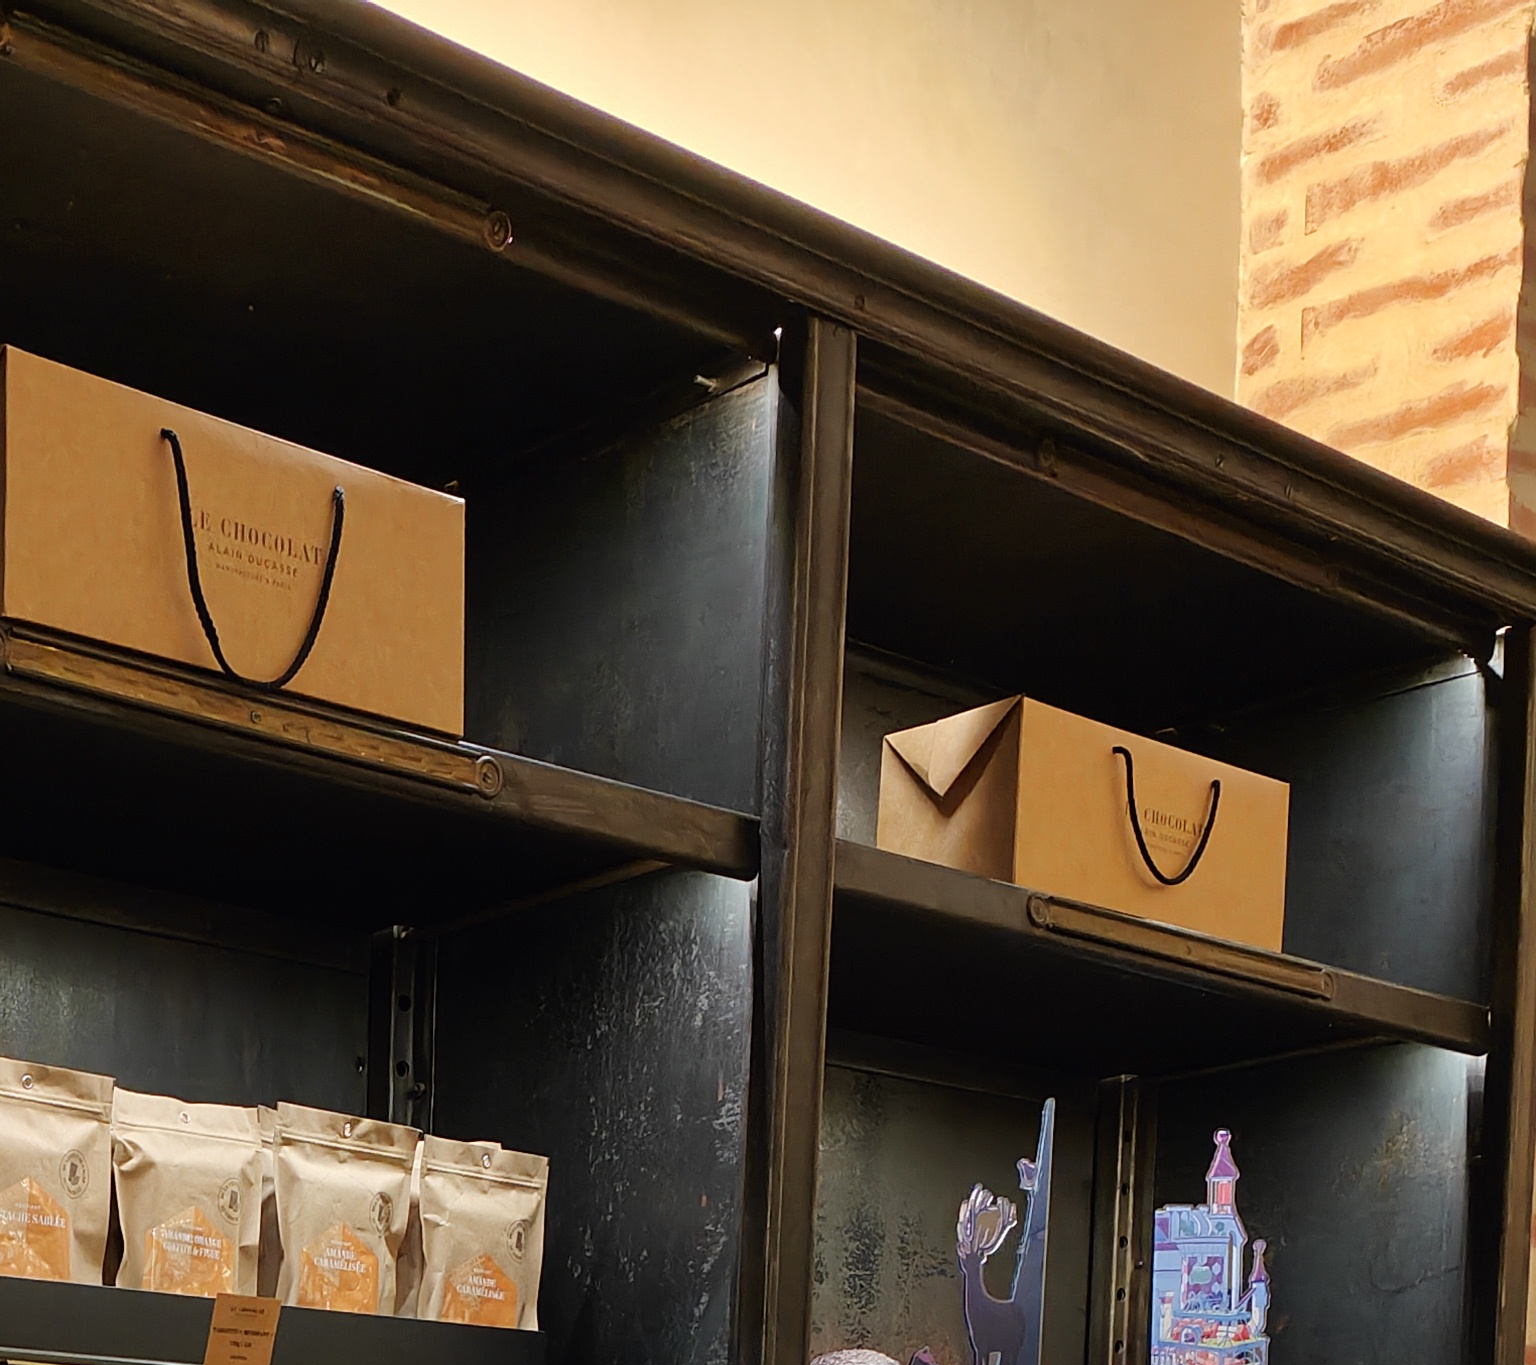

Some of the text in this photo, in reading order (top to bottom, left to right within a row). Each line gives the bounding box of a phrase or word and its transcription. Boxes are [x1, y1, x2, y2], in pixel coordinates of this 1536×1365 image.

[221, 518, 322, 566] CHOCOLAT
[208, 542, 298, 578] ALAIN DUCASSE
[32, 1213, 66, 1229] SABLÉE
[325, 1247, 357, 1260] AMANDE
[468, 1275, 496, 1288] AMANDE
